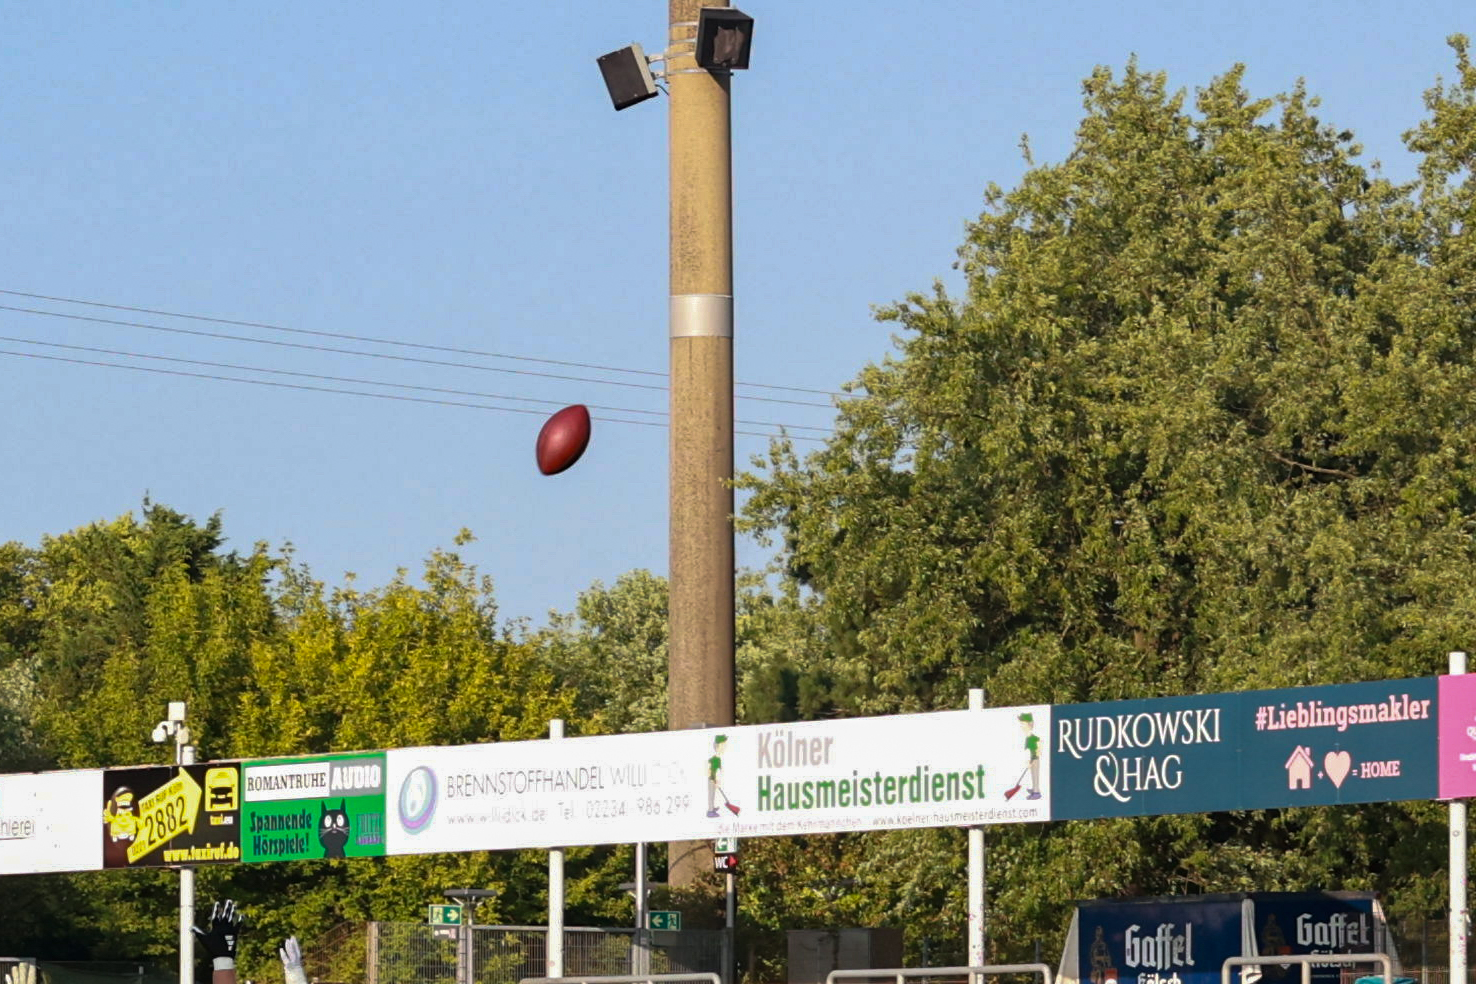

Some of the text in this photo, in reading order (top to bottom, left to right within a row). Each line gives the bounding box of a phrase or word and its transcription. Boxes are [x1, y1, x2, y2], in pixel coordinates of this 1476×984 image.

[1255, 695, 1430, 733] #Lieblingsmakler
[757, 729, 834, 769] Kölner
[1057, 708, 1221, 759] RUDKOWSKI
[247, 764, 381, 792] ROMANTRUHE AUDIO
[446, 766, 604, 798] BRENNSTOFFHANDEL
[1360, 760, 1401, 779] HOME
[757, 764, 985, 812] Hausmeisterdienst
[145, 796, 188, 845] 2882
[250, 808, 312, 833] Spannende
[253, 832, 309, 860] Hörspiele!
[714, 856, 728, 869] WC
[1125, 922, 1194, 970] Gaffel
[1296, 912, 1369, 948] Gaffel
